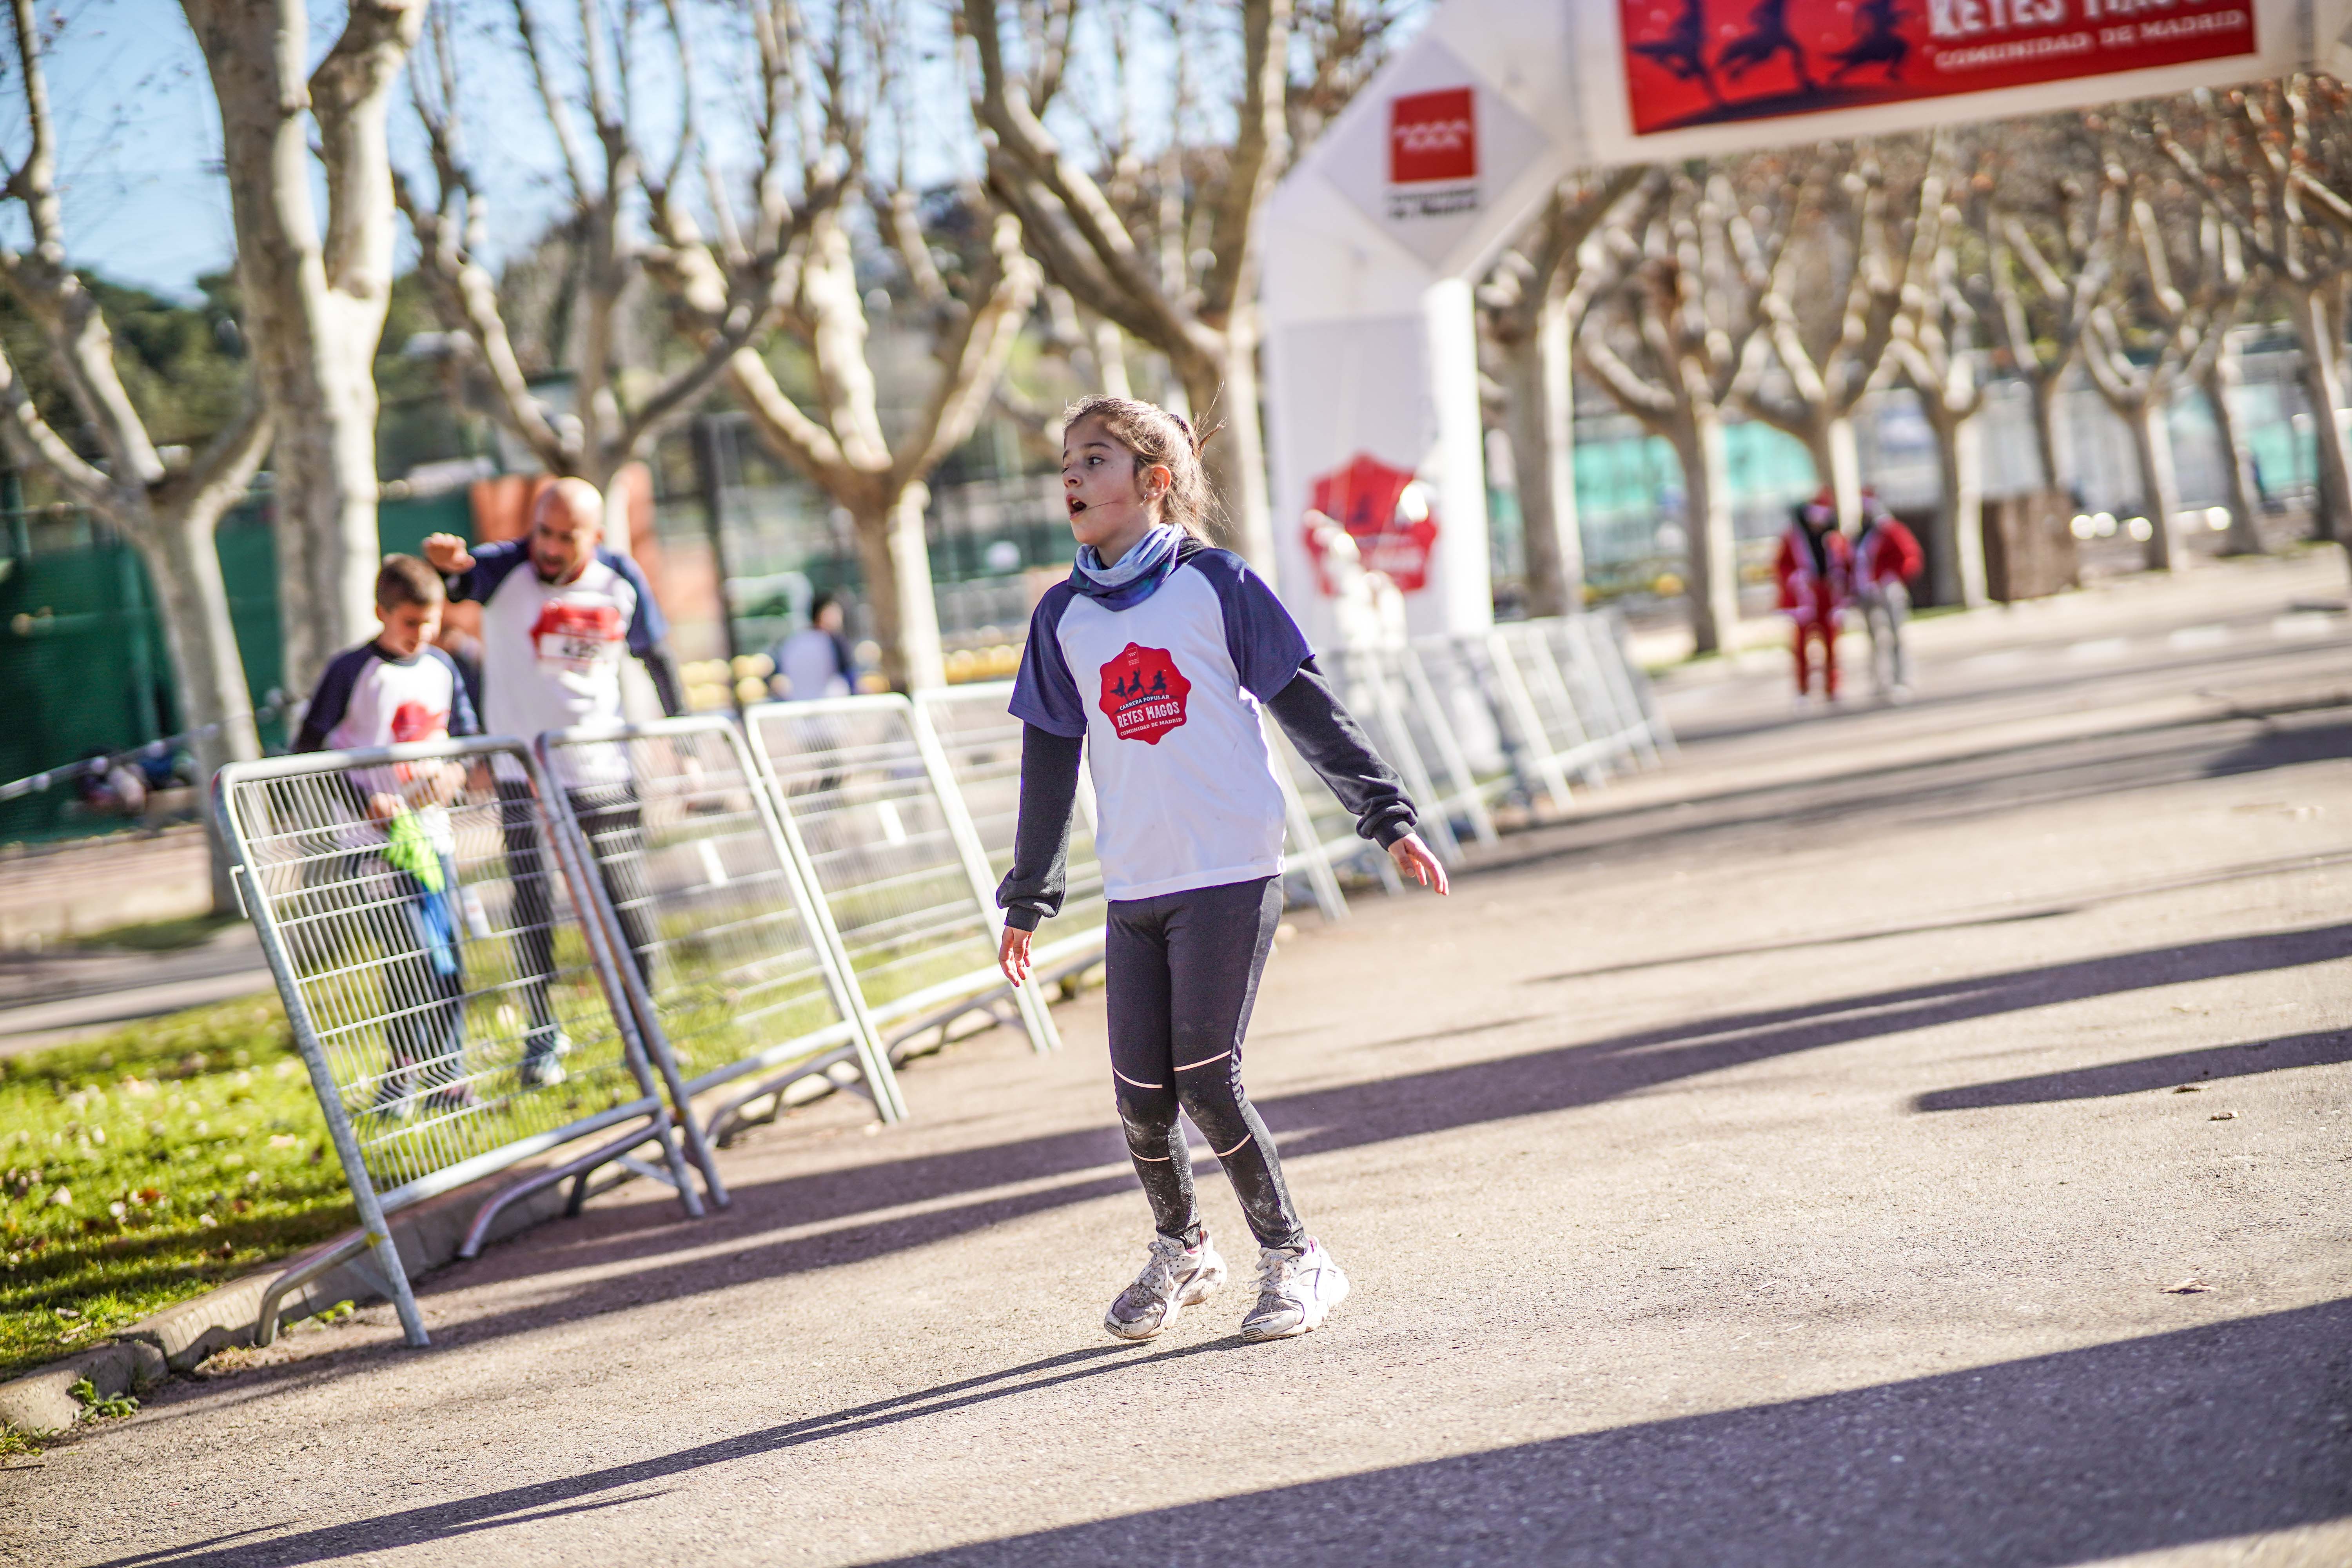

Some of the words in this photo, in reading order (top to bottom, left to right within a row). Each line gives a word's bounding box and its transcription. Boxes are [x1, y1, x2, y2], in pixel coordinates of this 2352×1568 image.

[1935, 33, 2092, 69] COMUNIDAD
[2100, 25, 2136, 45] DE
[2140, 10, 2247, 38] MADRID
[1120, 699, 1142, 710] CARRERA
[1117, 709, 1144, 728] REYES
[1145, 701, 1180, 720] MAGOS
[1120, 724, 1150, 736] COMUNIDAD
